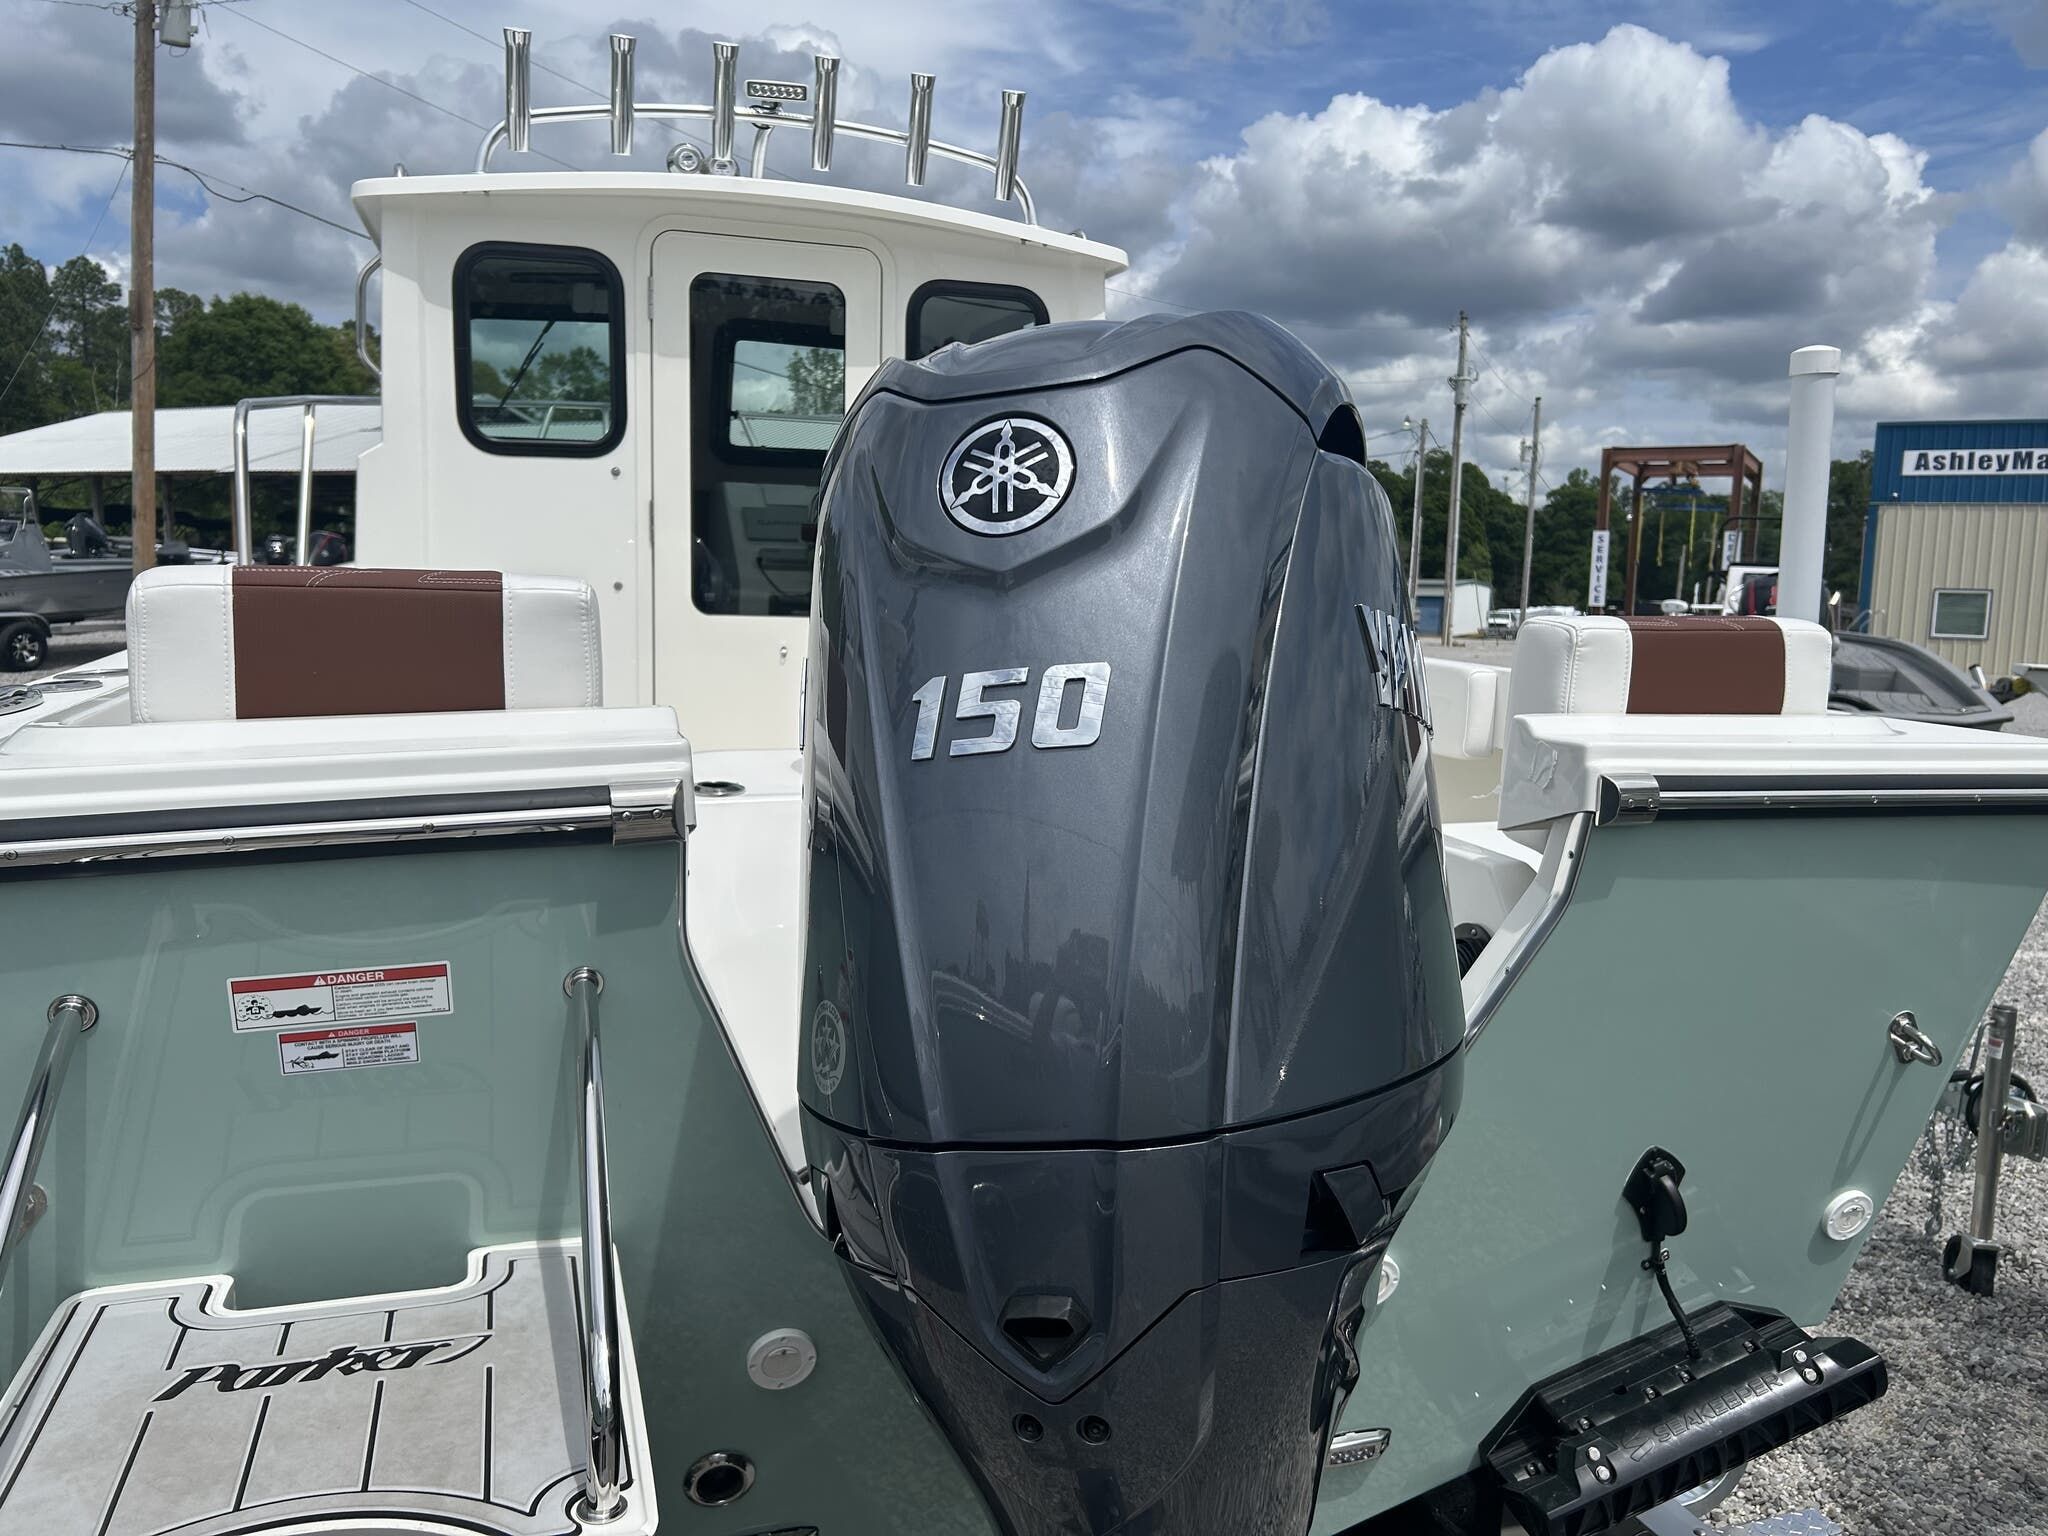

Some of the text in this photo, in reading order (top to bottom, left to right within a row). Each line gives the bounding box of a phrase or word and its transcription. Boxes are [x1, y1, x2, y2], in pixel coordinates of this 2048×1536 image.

[1914, 450, 2048, 472] AshleyMa
[1593, 534, 1606, 604] SERVICE
[911, 661, 1112, 761] 150
[327, 971, 384, 984] DANGER
[338, 1028, 370, 1036] DANGER
[152, 1334, 492, 1402] Parker
[1654, 1372, 1784, 1442] SEAKEEPER
